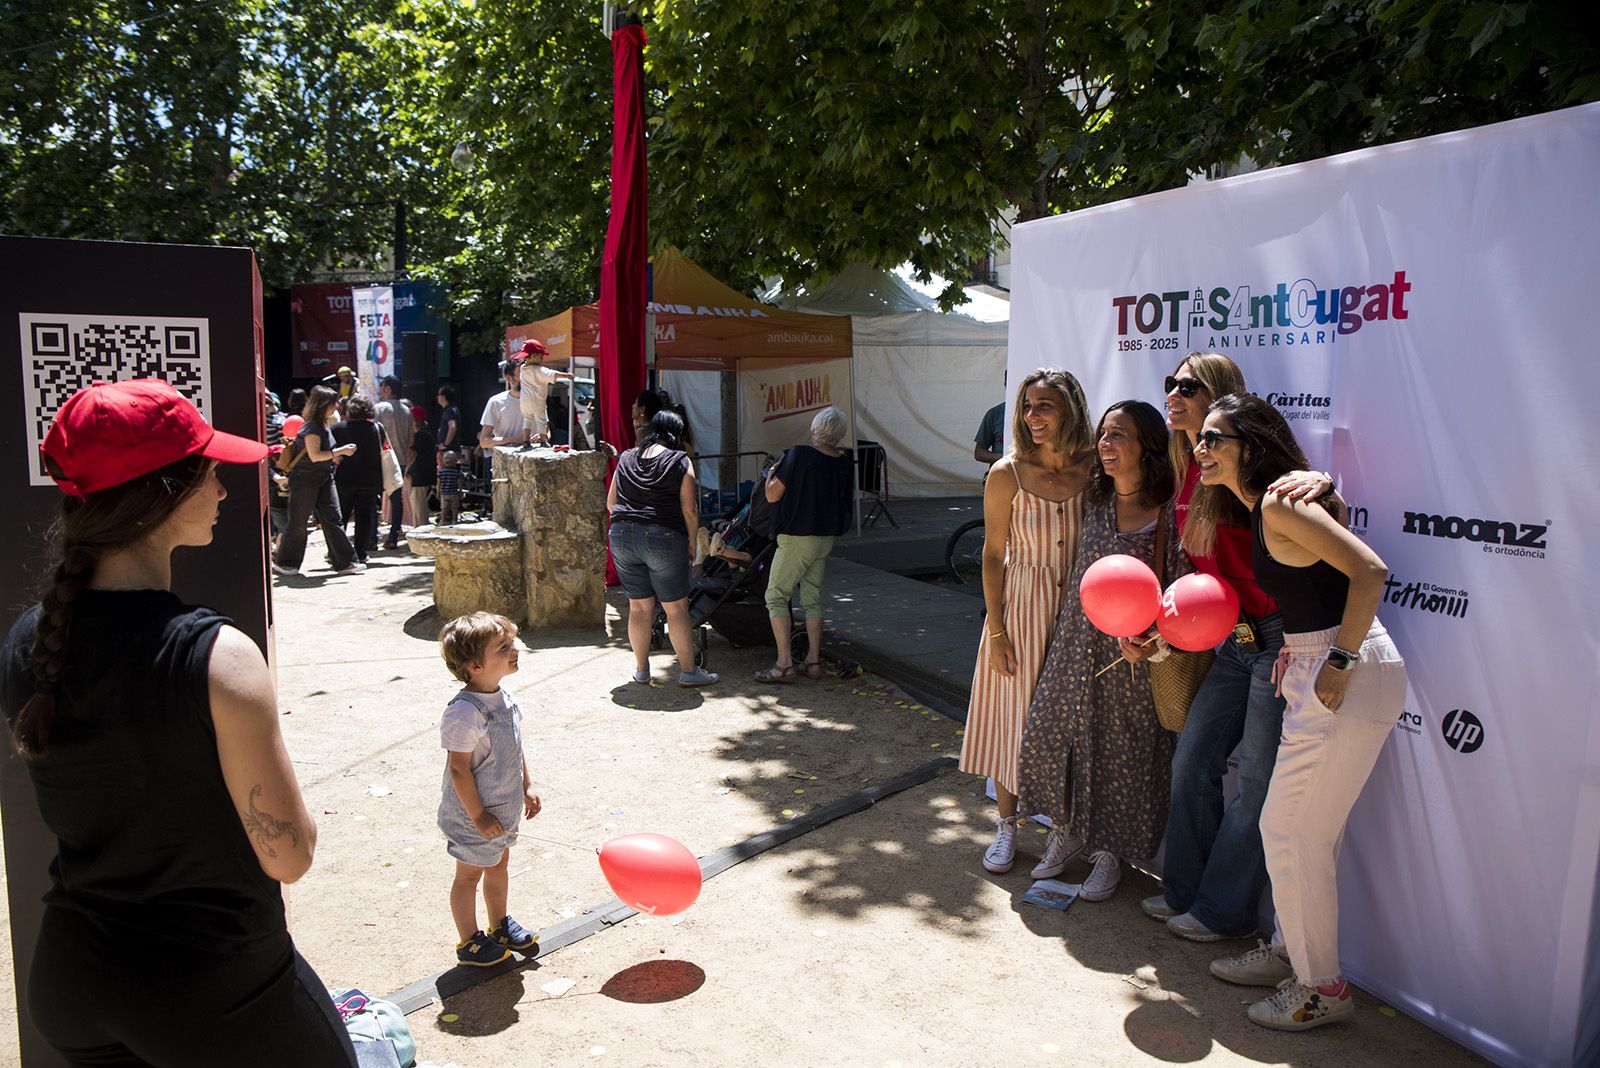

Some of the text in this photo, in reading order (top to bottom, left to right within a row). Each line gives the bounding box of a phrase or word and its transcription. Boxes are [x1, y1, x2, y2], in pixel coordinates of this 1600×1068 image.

[653, 303, 769, 317] MBAUKA
[1112, 290, 1189, 335] TOT
[767, 331, 834, 343] ambauka.cat
[1208, 330, 1336, 348] ANIVERSARI
[1118, 340, 1142, 351] 1985
[1150, 338, 1179, 350] 2025
[1266, 392, 1332, 407] Càritas
[1403, 512, 1548, 549] moonz
[1495, 545, 1546, 559] ortodòncia
[1431, 584, 1457, 595] Govern
[1458, 589, 1469, 597] de
[1443, 709, 1483, 753] hp
